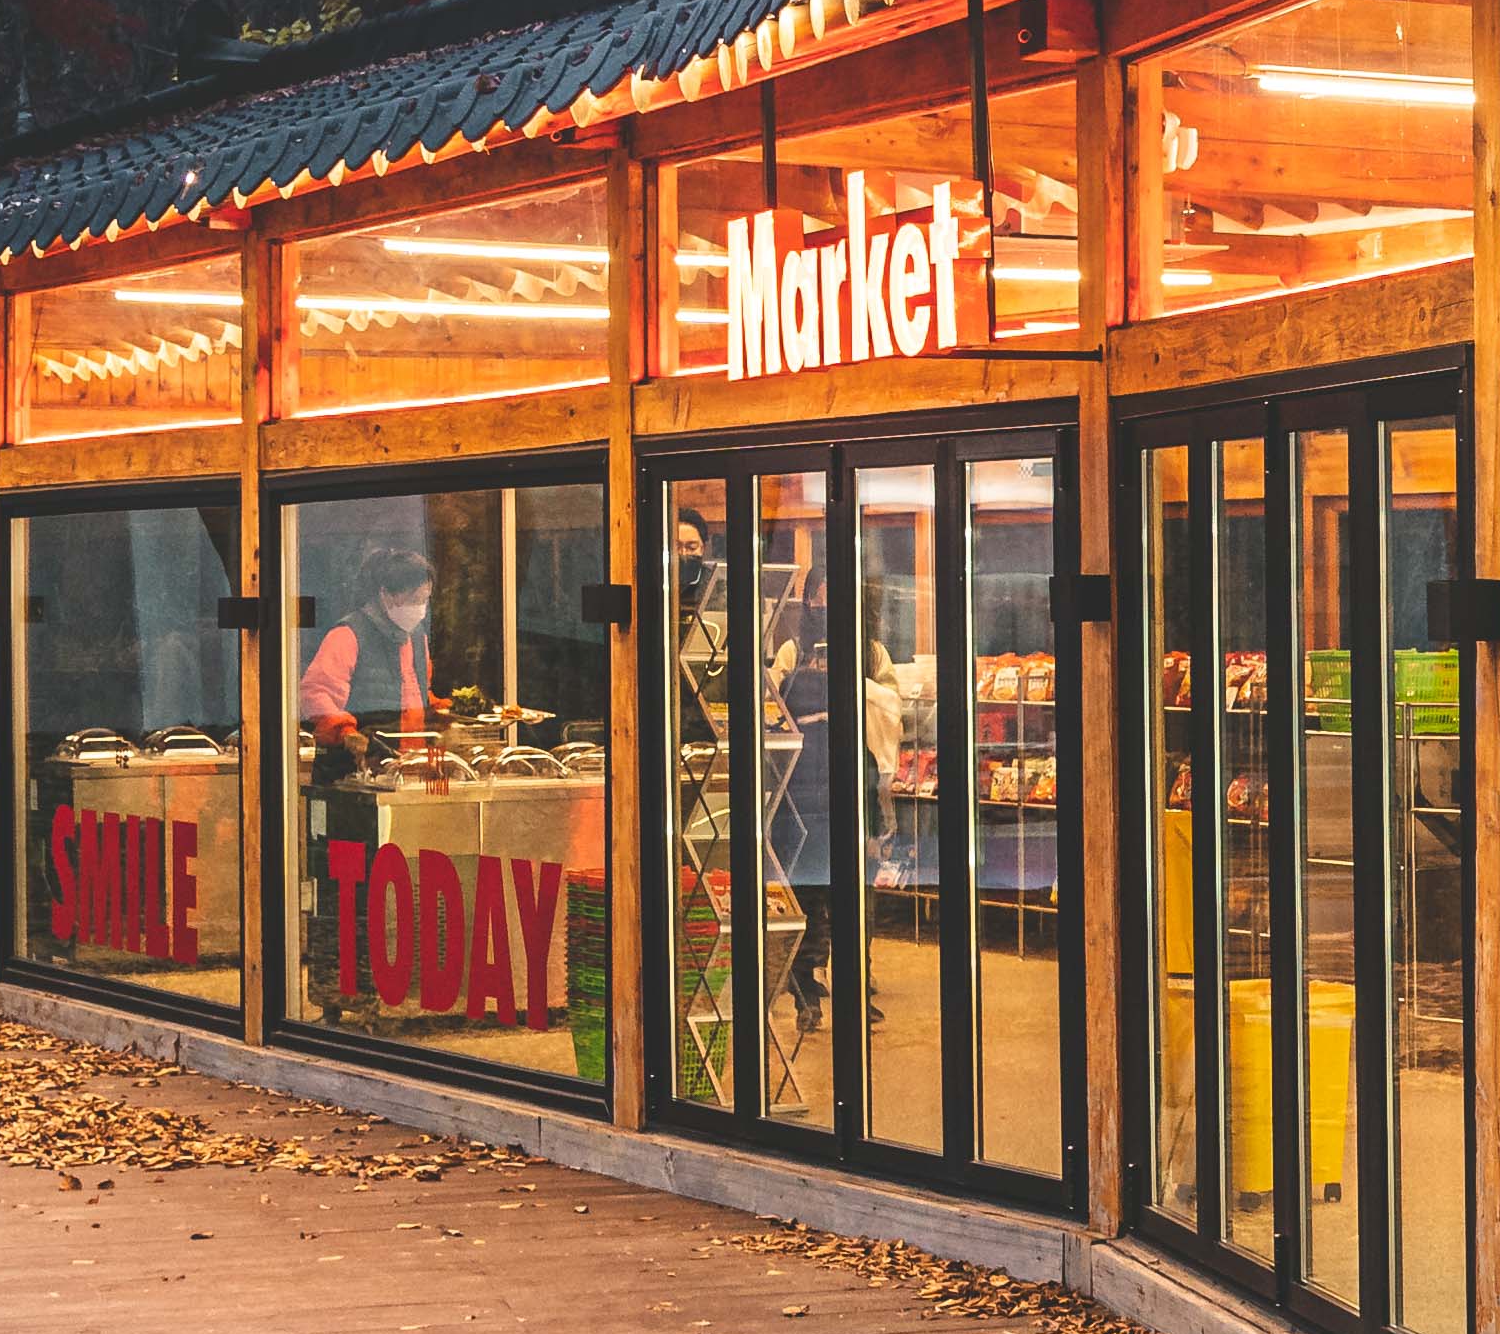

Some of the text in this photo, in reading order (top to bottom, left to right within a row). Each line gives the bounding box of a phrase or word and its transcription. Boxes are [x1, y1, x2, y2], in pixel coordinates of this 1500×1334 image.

[727, 169, 959, 381] Market
[52, 804, 198, 964] SMILE
[328, 840, 564, 1031] TODAY
